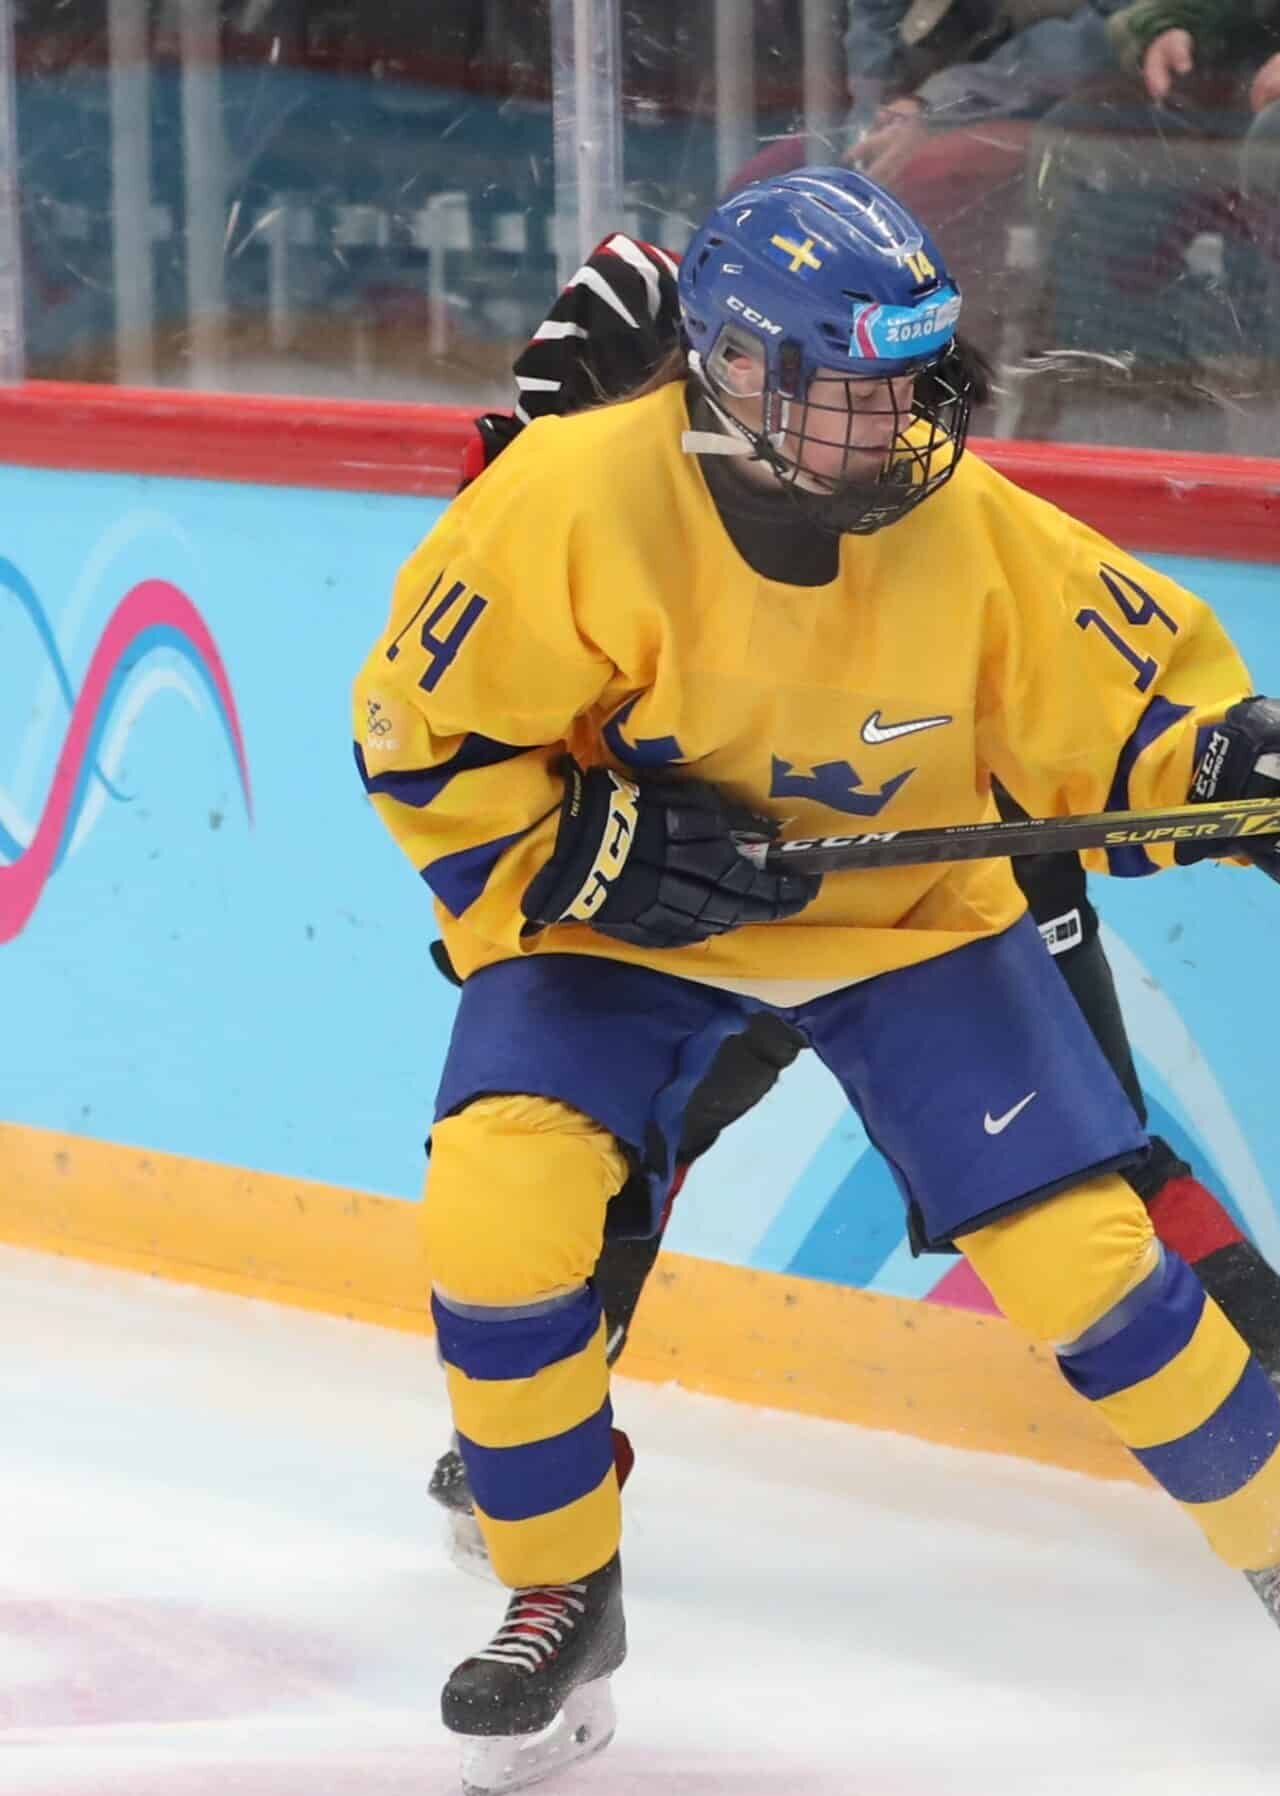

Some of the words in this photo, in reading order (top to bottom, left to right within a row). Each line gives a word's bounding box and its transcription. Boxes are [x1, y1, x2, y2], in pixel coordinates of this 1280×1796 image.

[905, 252, 936, 284] 14
[725, 295, 784, 336] CCM
[884, 319, 933, 343] 2020
[1074, 561, 1179, 694] 14
[1195, 731, 1222, 798] CCM
[780, 831, 900, 852] CCM
[1104, 823, 1221, 844] SUPER
